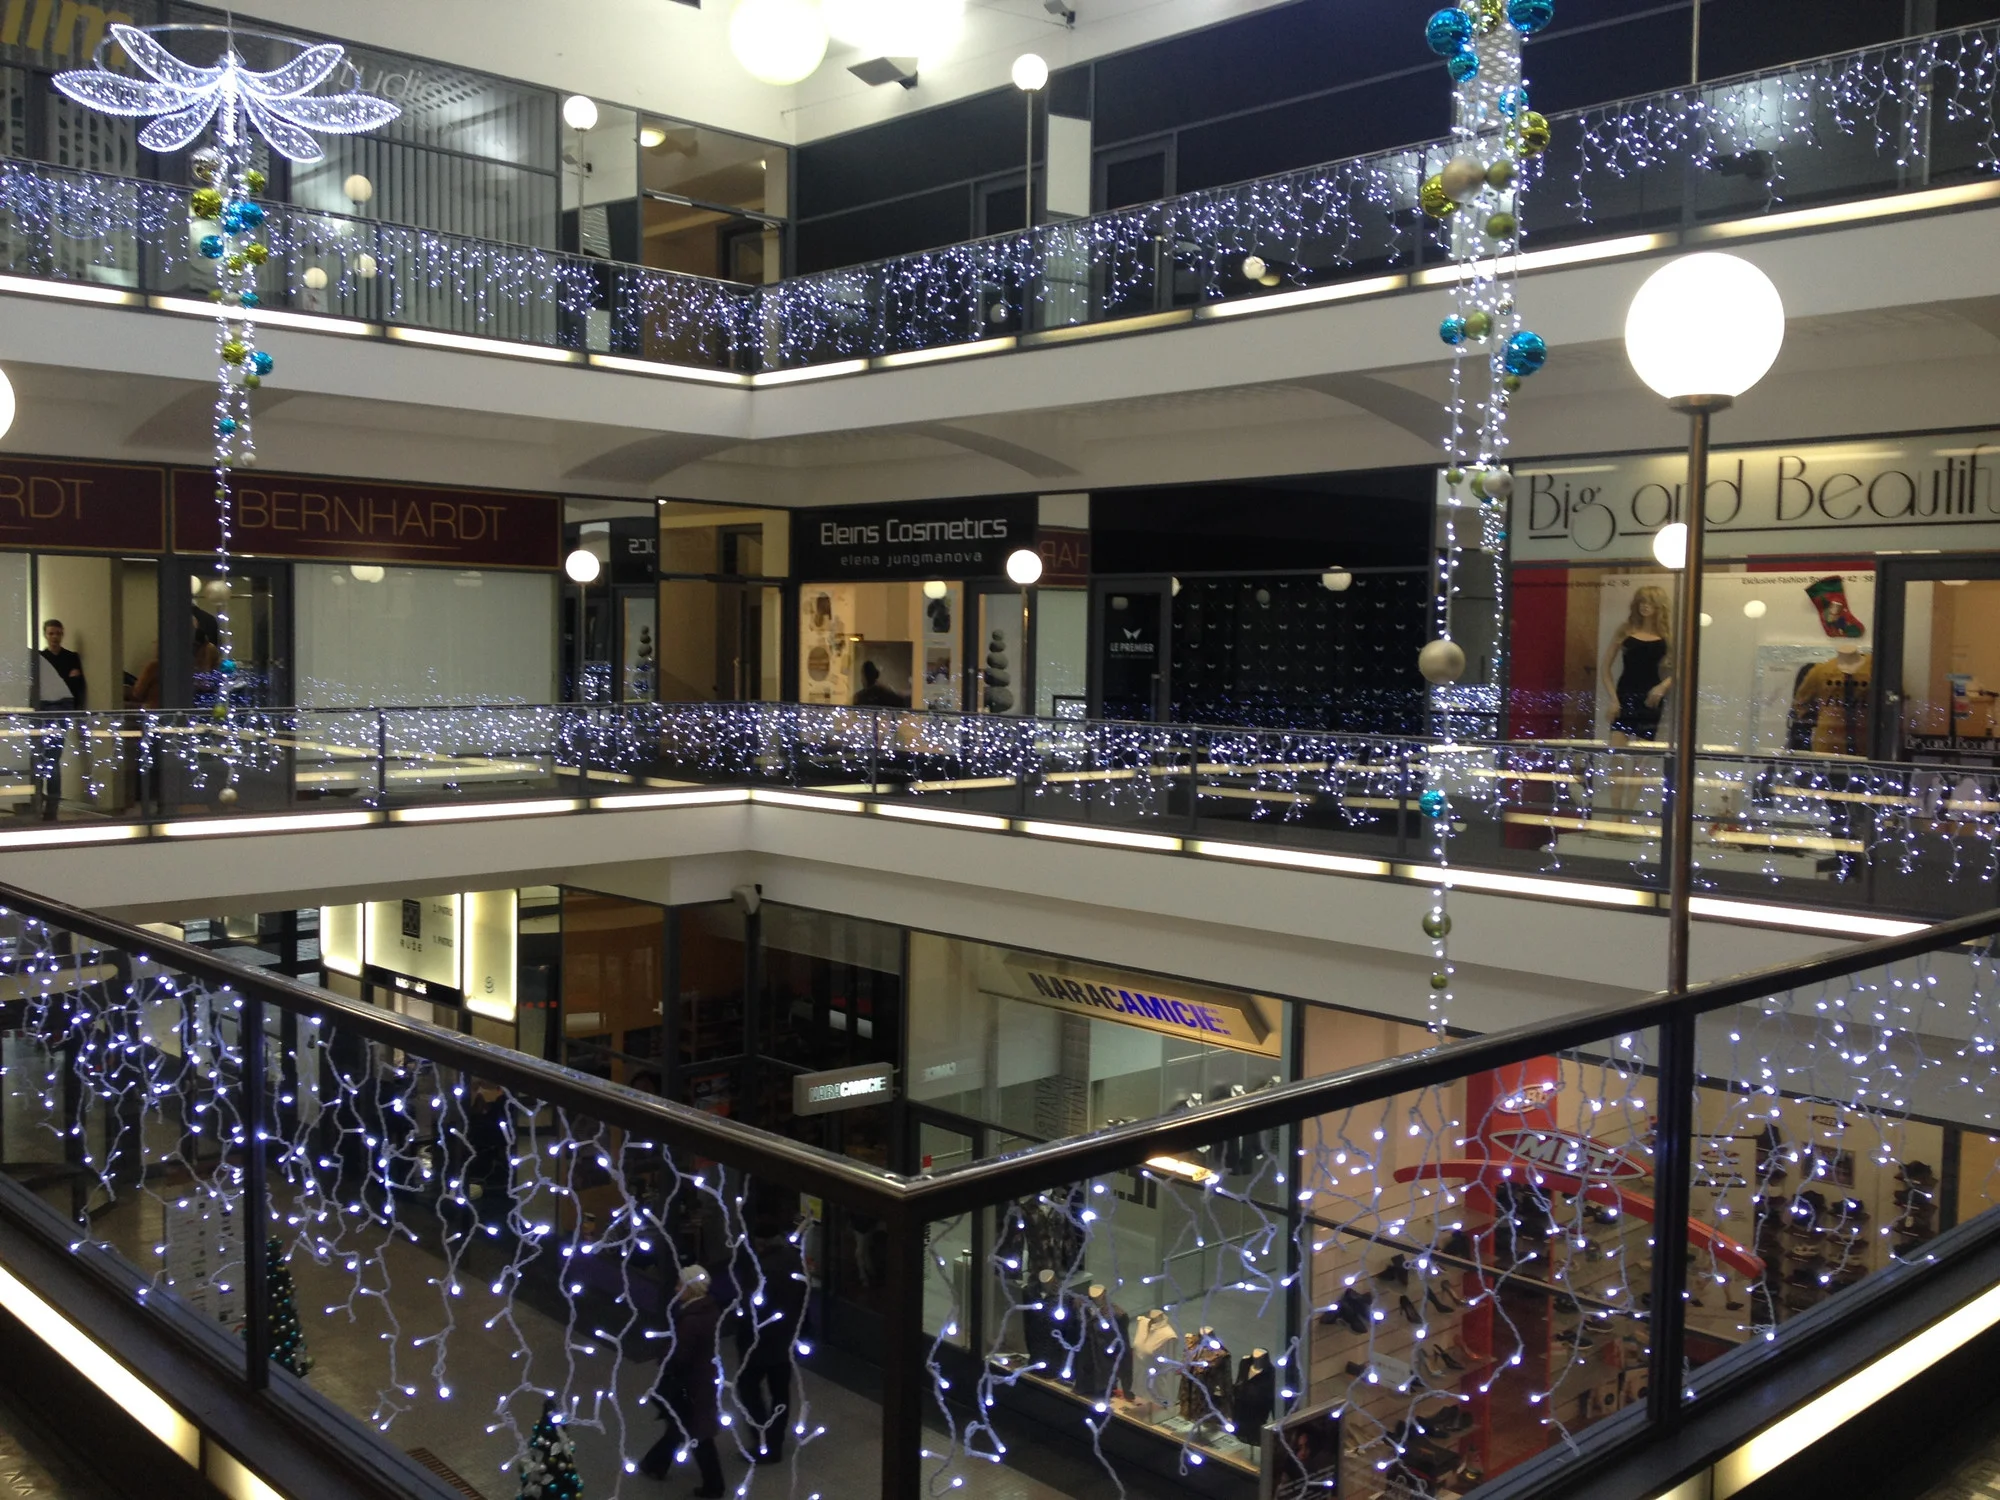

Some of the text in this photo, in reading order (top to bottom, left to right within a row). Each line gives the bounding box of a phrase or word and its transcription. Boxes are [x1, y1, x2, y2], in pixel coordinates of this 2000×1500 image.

[322, 57, 444, 104] tudio
[238, 489, 507, 541] BERNHARDT
[820, 516, 1008, 546] Eleins Cosmetics
[1529, 472, 1616, 552] Big
[840, 551, 983, 568] elena jungmanova
[1109, 642, 1155, 653] LE PREMIER
[1028, 972, 1231, 1036] NARACAMICIE
